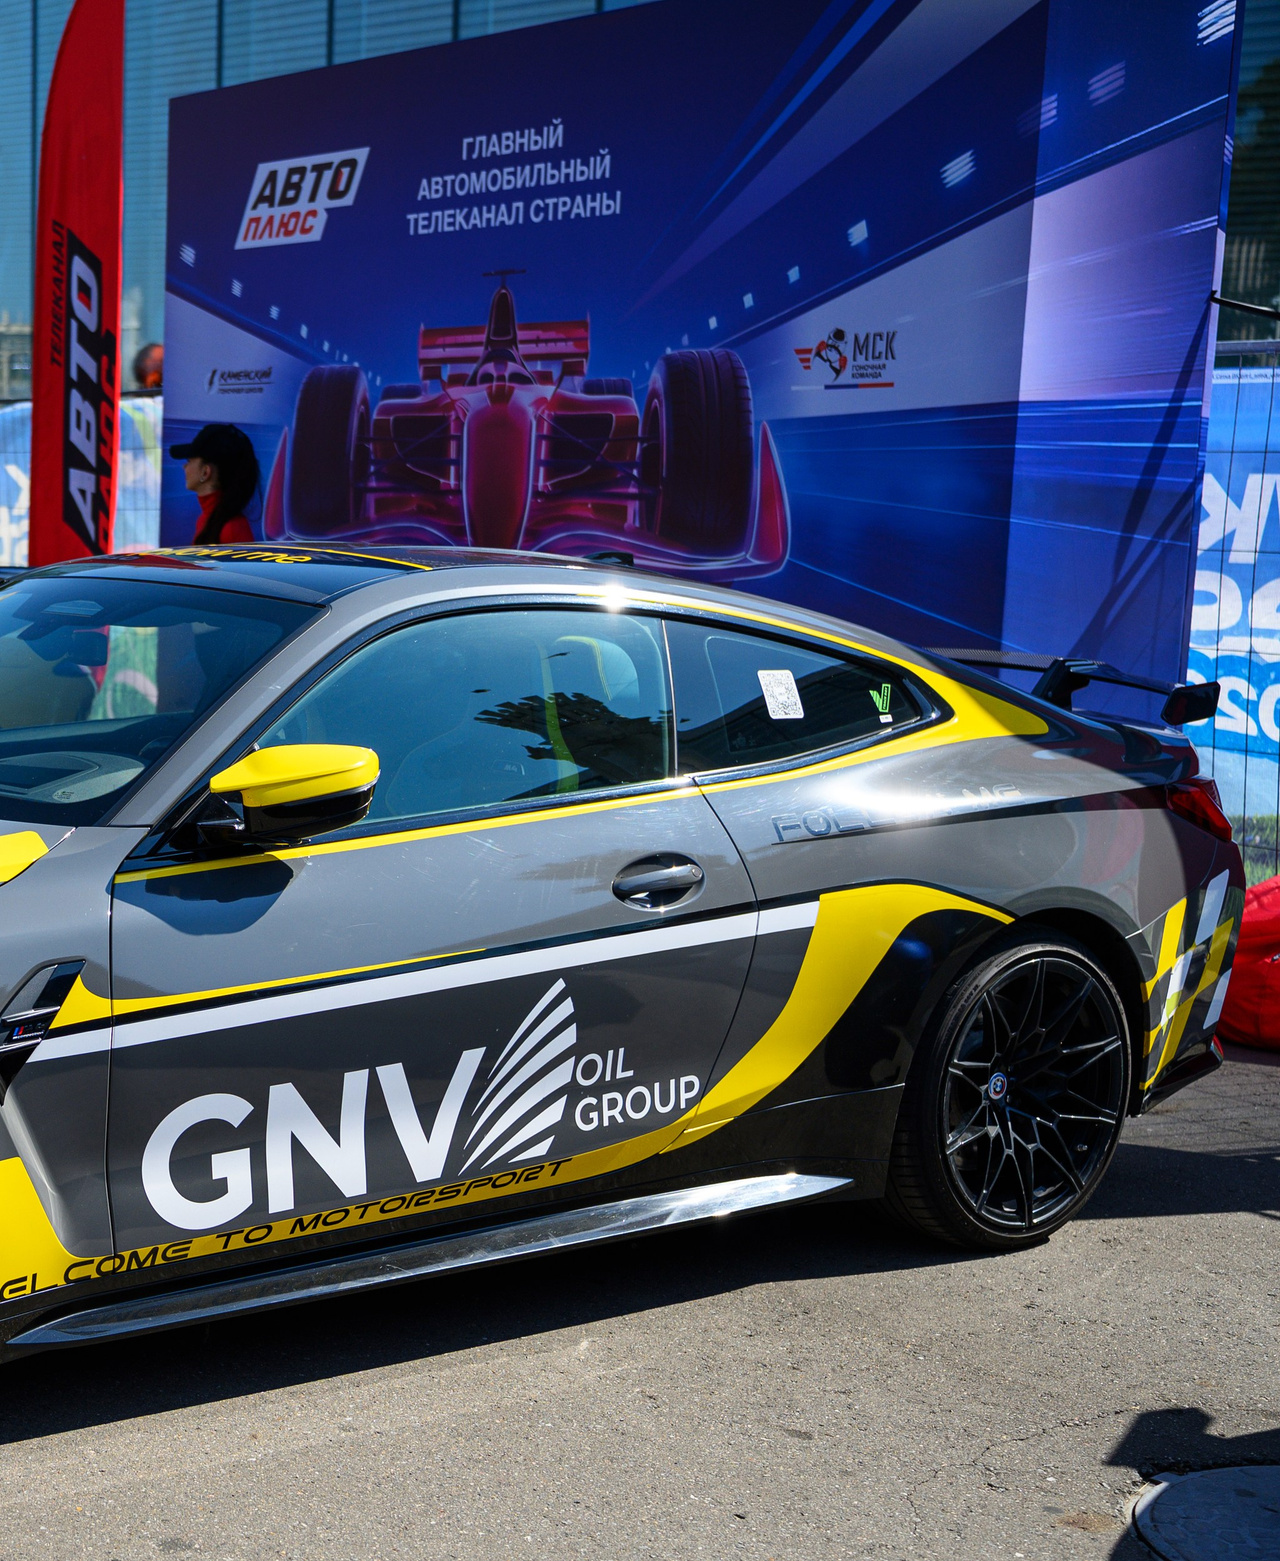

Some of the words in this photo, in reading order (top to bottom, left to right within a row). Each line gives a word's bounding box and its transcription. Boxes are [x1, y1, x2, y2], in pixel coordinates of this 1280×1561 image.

[461, 118, 565, 161] ГЛАВНЫЙ
[250, 157, 359, 212] АВТО
[417, 149, 611, 202] АВТОМОБИЛЬНЫЙ
[242, 208, 319, 242] ПЛЮС
[406, 205, 525, 237] ТЕЛЕКАНАЛ
[529, 190, 622, 225] СТРАНЫ
[50, 219, 66, 369] ТЕЛЕКАНАЛ
[852, 330, 898, 363] МСК
[69, 254, 99, 542] АВТО
[574, 1046, 635, 1087] OIL
[574, 1074, 702, 1133] GROUP
[140, 1046, 488, 1232] GNV
[215, 1223, 275, 1250] TO
[289, 1157, 573, 1236] MOTORSPORT
